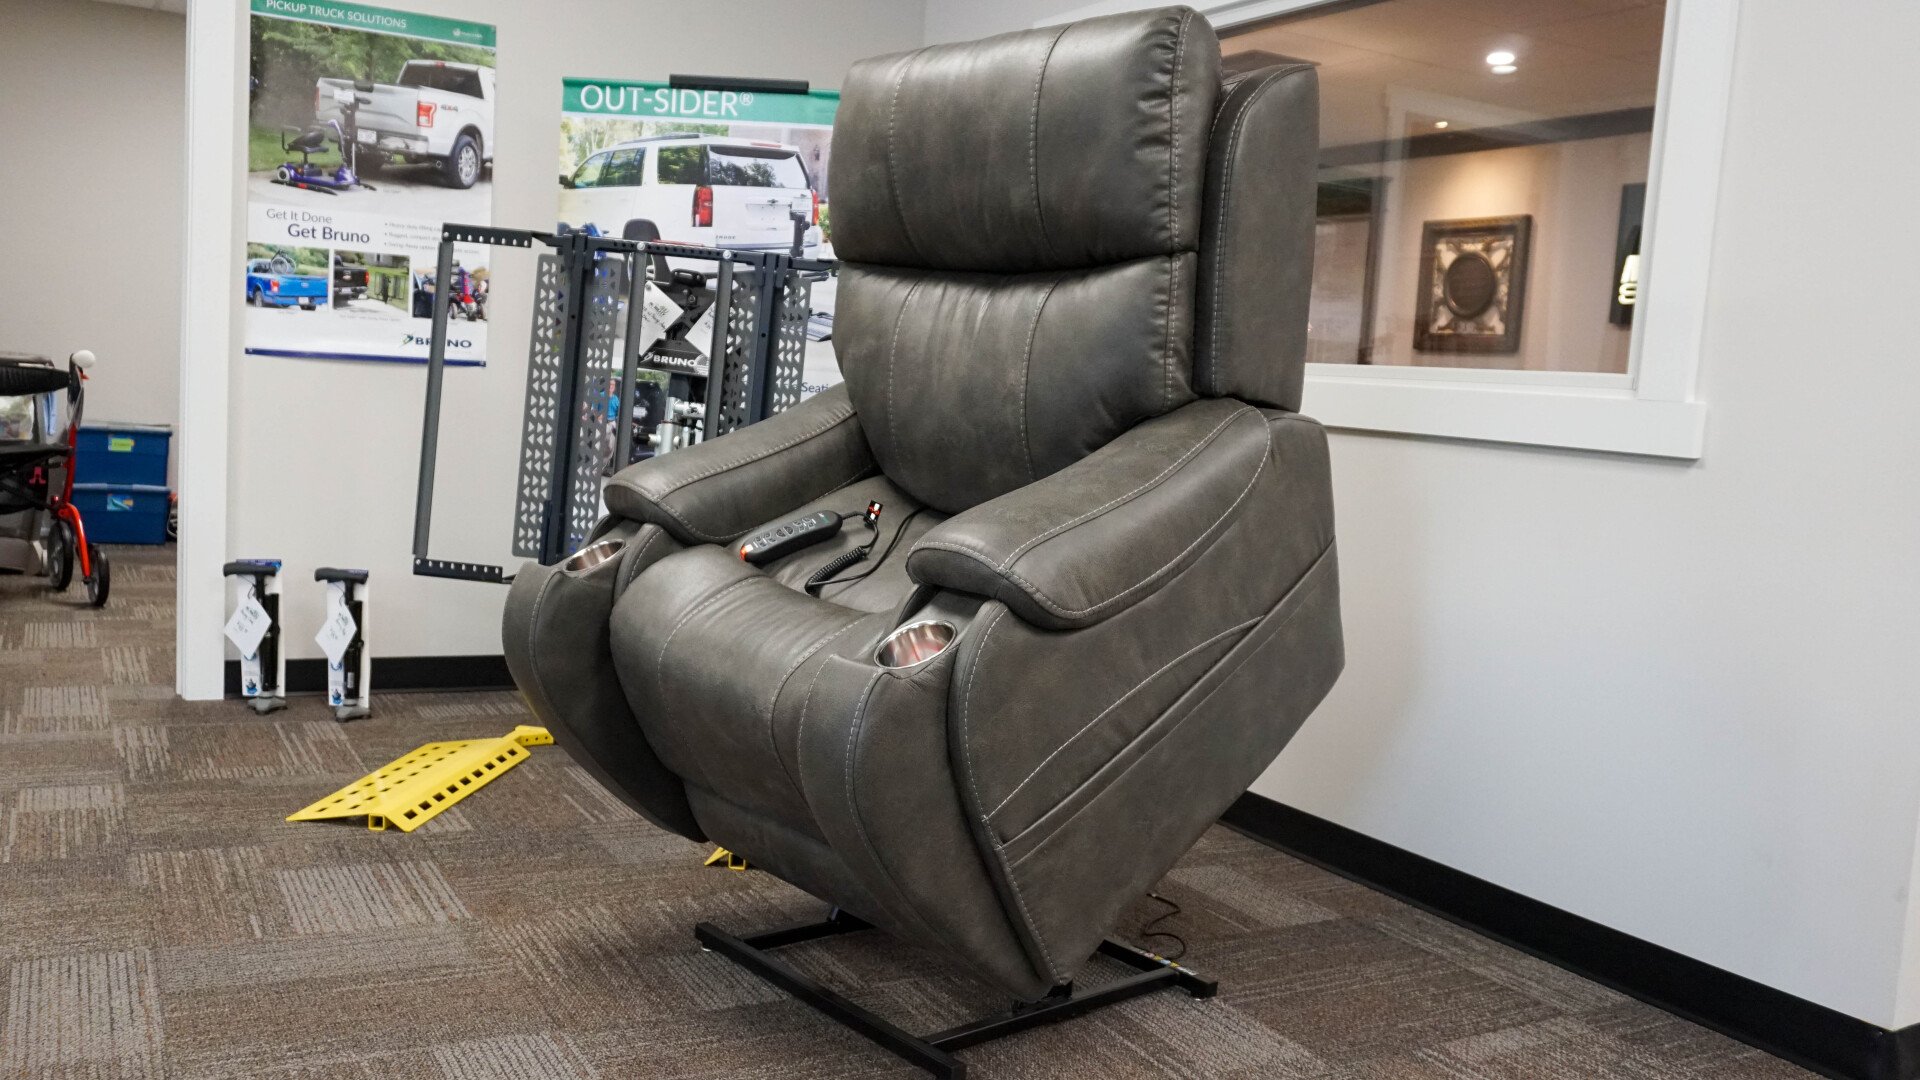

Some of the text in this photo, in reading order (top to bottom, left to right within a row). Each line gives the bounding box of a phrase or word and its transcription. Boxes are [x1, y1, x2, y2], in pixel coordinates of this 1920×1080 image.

[266, 0, 407, 29] PICKUP TRUCK SOLUTIONS
[266, 208, 333, 224] Get It Done
[287, 223, 370, 244] Get Bruno
[415, 337, 472, 348] BRNO
[653, 355, 698, 367] BRUNO
